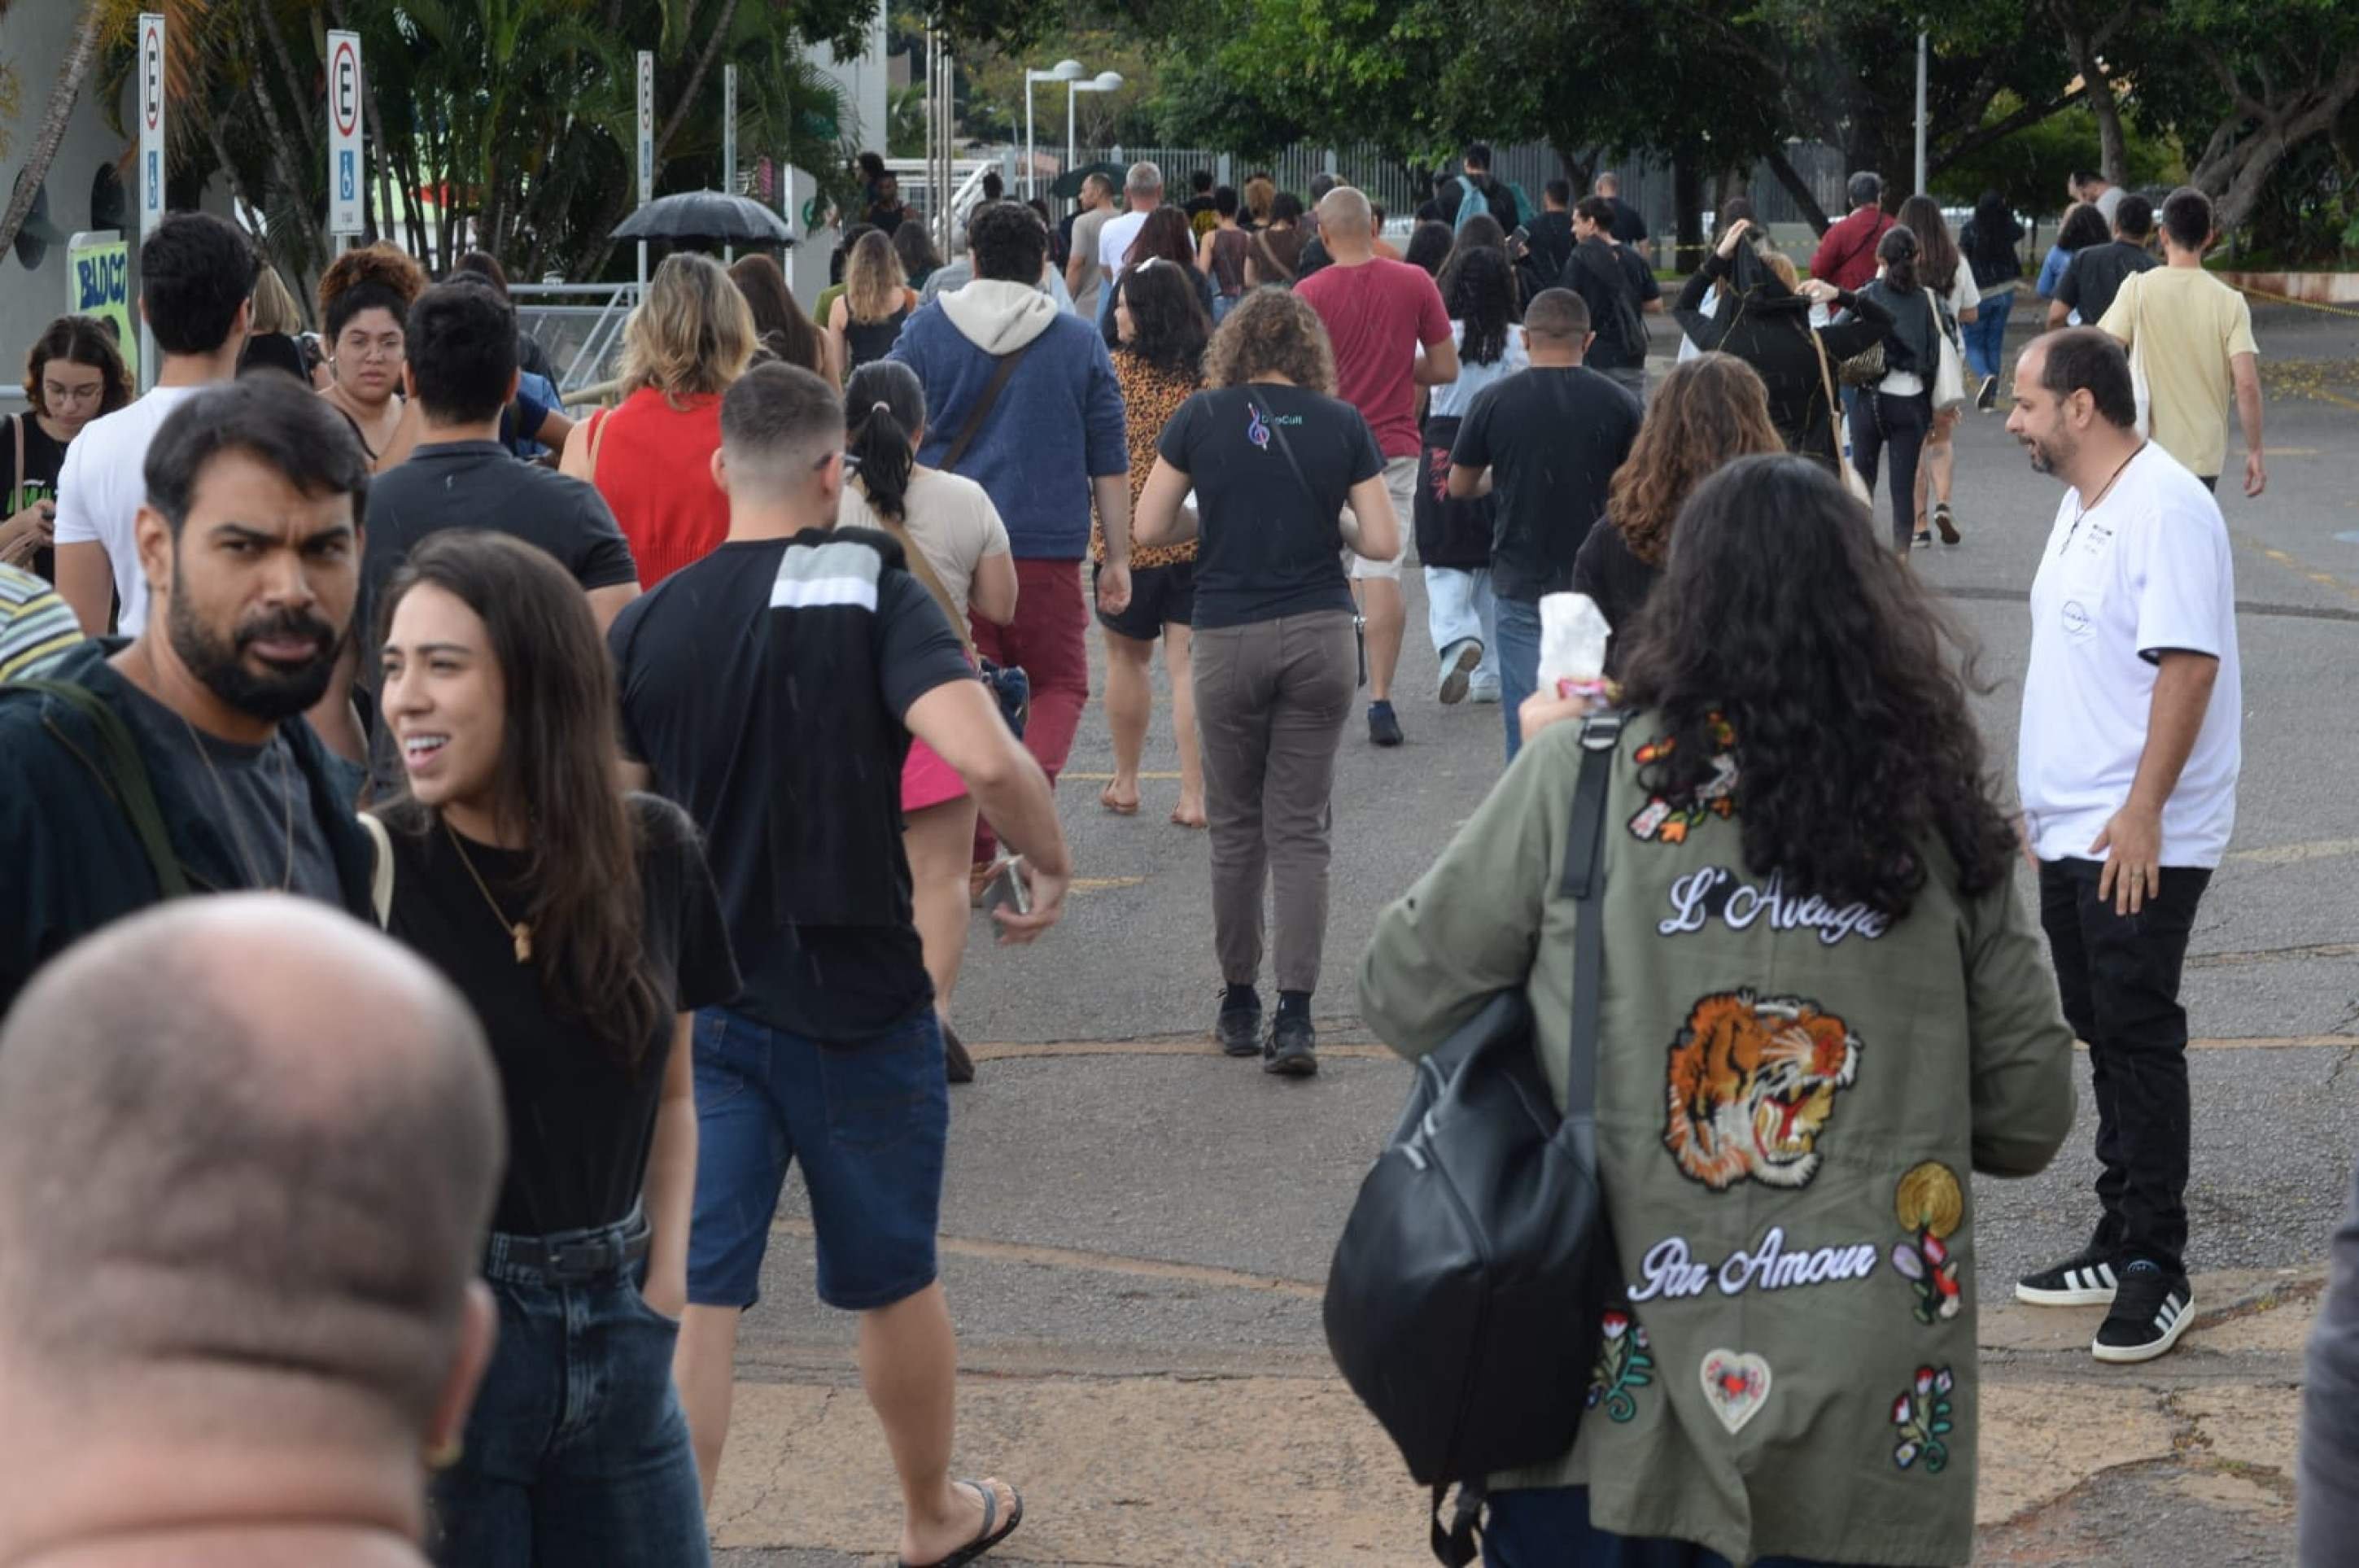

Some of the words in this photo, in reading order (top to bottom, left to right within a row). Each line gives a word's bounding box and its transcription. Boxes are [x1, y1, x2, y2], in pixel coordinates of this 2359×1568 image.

[148, 50, 157, 112] E
[340, 63, 352, 115] E
[1627, 1237, 1708, 1301] Par
[1718, 1226, 1876, 1295] Amour
